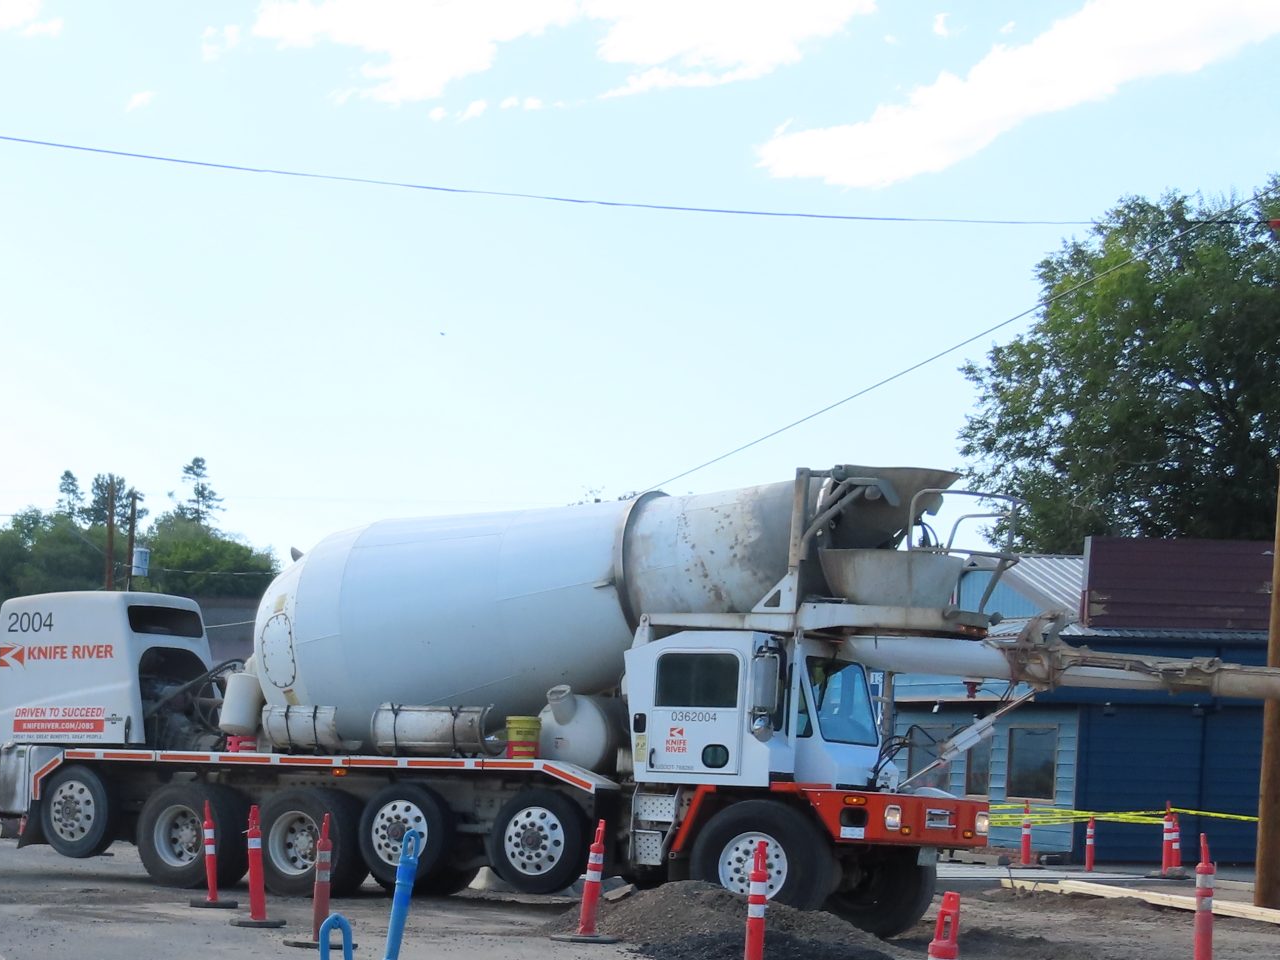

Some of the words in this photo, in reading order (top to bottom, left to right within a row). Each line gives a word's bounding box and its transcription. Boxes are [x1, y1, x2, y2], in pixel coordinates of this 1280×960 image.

[8, 612, 54, 632] 2004
[28, 646, 68, 660] KNIFE
[72, 644, 114, 659] RIVER
[15, 708, 46, 718] DRIVEN
[49, 708, 60, 718] TO
[62, 707, 105, 718] SUCCEED!
[671, 711, 717, 722] 0362004
[22, 722, 94, 730] KNIFERIVER.COM/JOBS
